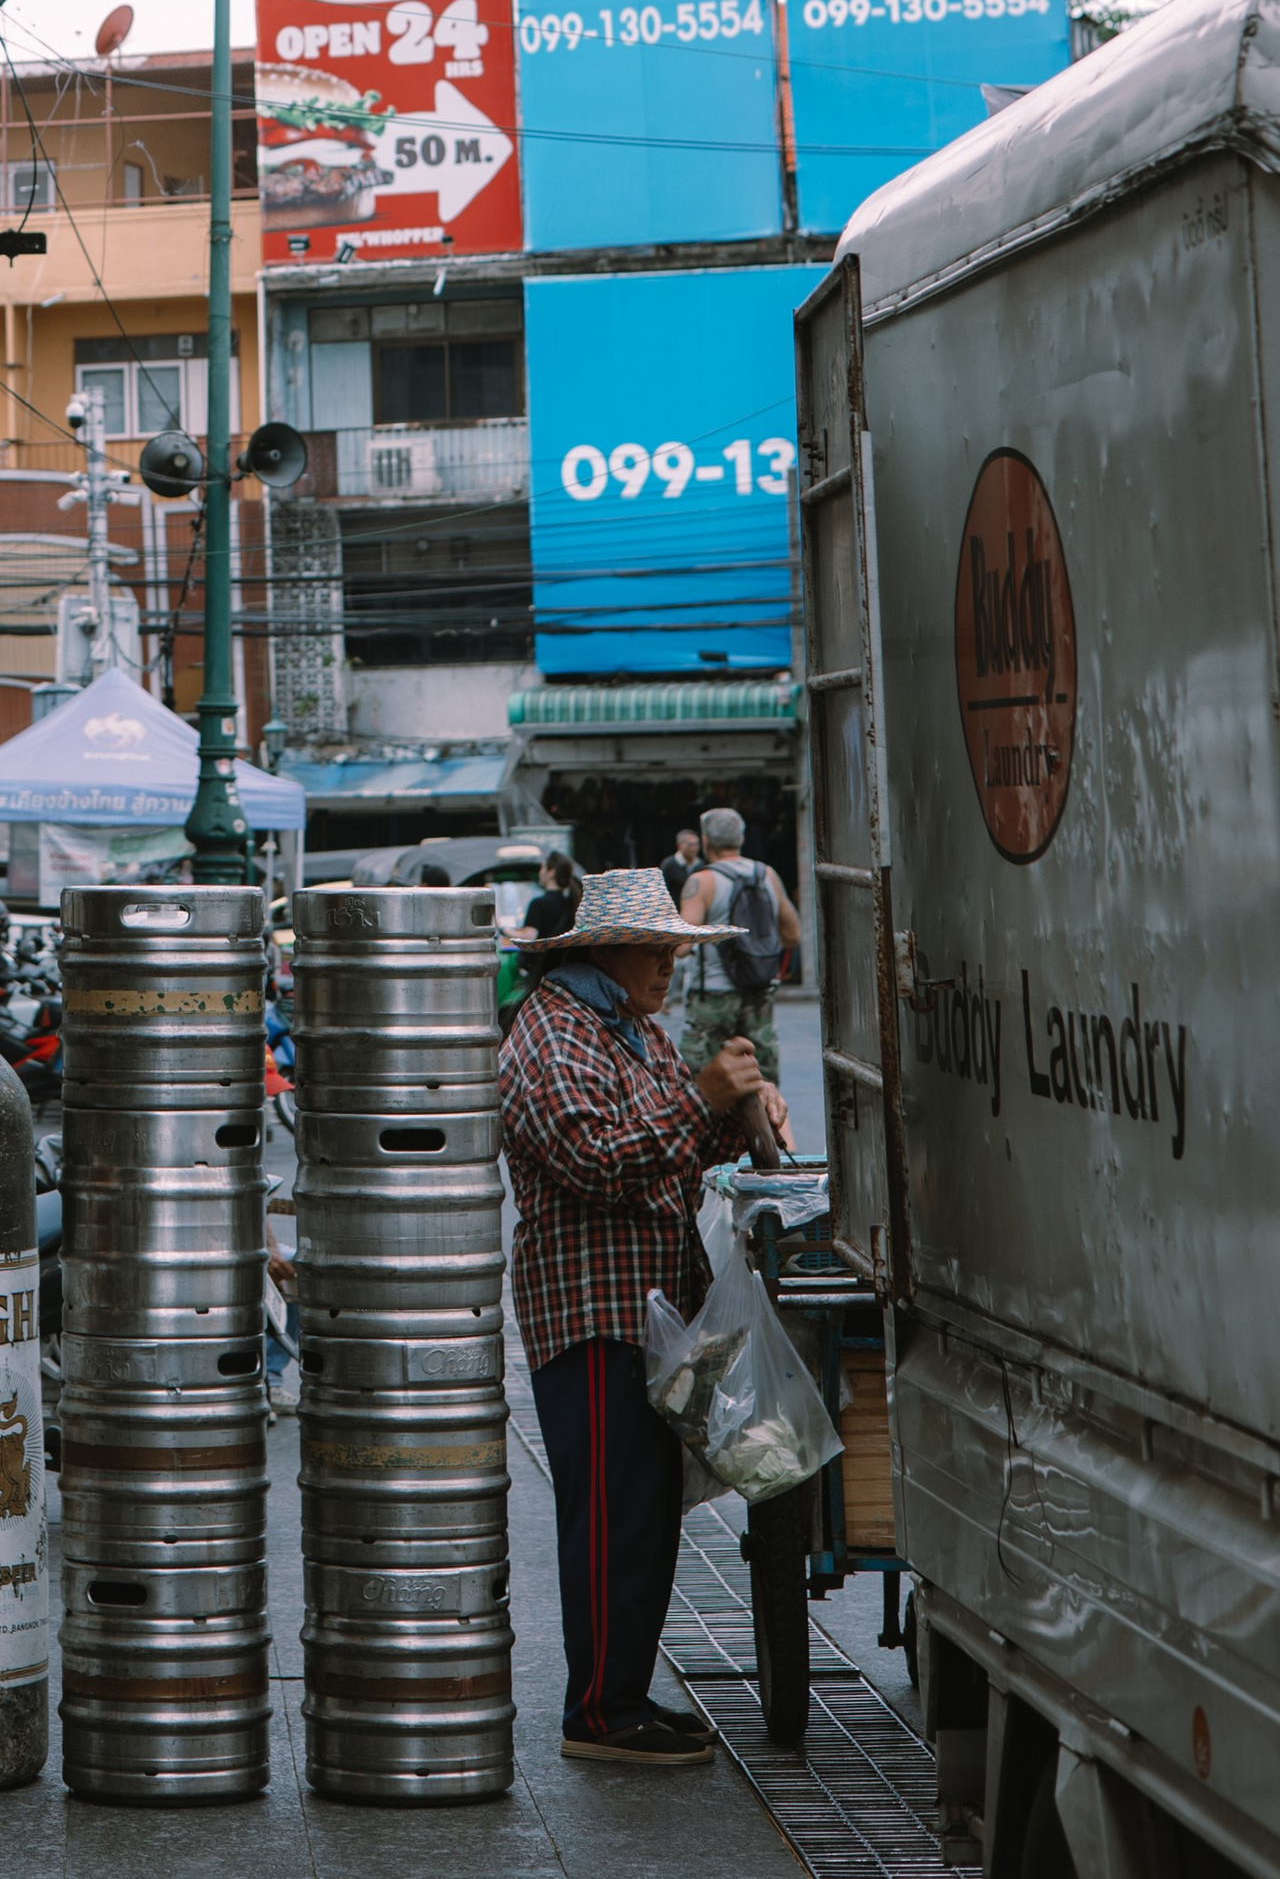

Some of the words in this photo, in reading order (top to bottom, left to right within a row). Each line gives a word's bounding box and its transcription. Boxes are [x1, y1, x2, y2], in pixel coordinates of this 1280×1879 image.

[276, 20, 381, 61] OPEN
[445, 59, 484, 79] HRS
[394, 134, 446, 168] 50
[454, 138, 494, 165] M.
[561, 437, 795, 500] 099-13
[970, 528, 1055, 705] Buddy
[1022, 969, 1186, 1160] Laundry
